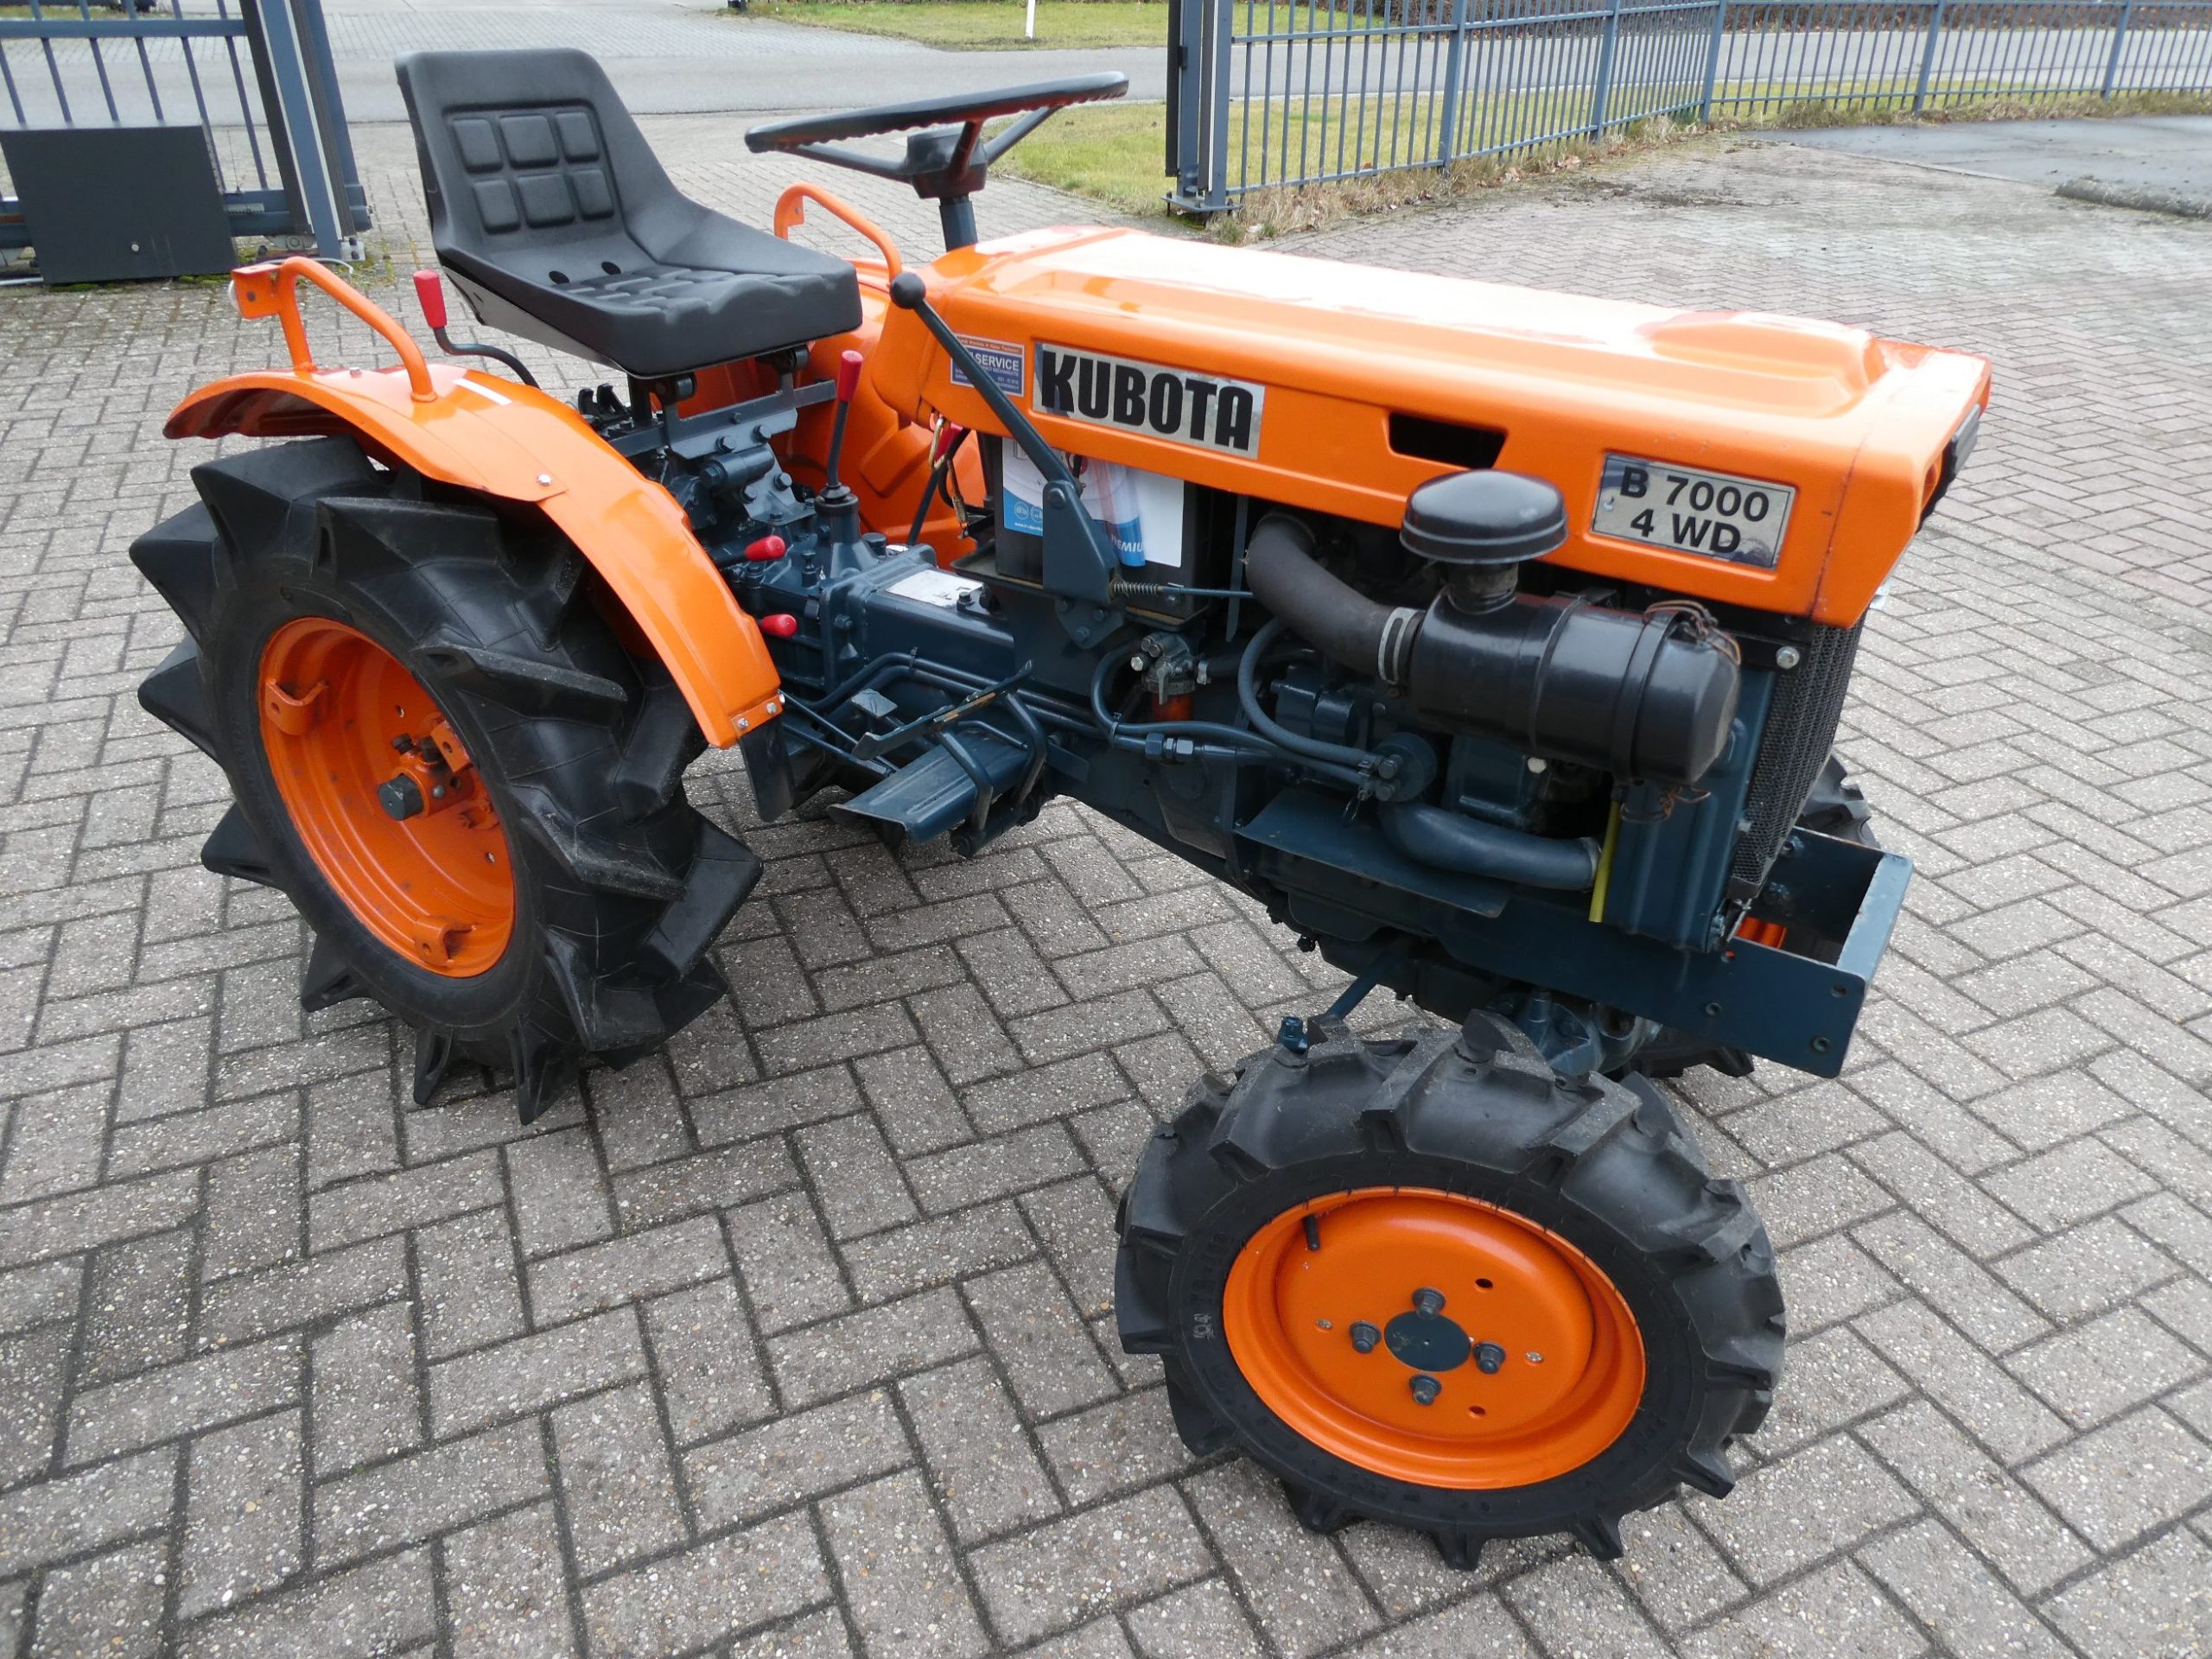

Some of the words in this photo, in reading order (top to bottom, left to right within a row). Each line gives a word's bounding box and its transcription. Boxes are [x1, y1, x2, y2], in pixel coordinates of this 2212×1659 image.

[976, 353, 1020, 372] SERVICE
[1042, 351, 1254, 451] KUBOTA
[1620, 466, 1649, 499] B
[1666, 475, 1770, 523] 7000
[1630, 508, 1655, 537] 4
[1673, 513, 1741, 553] WD
